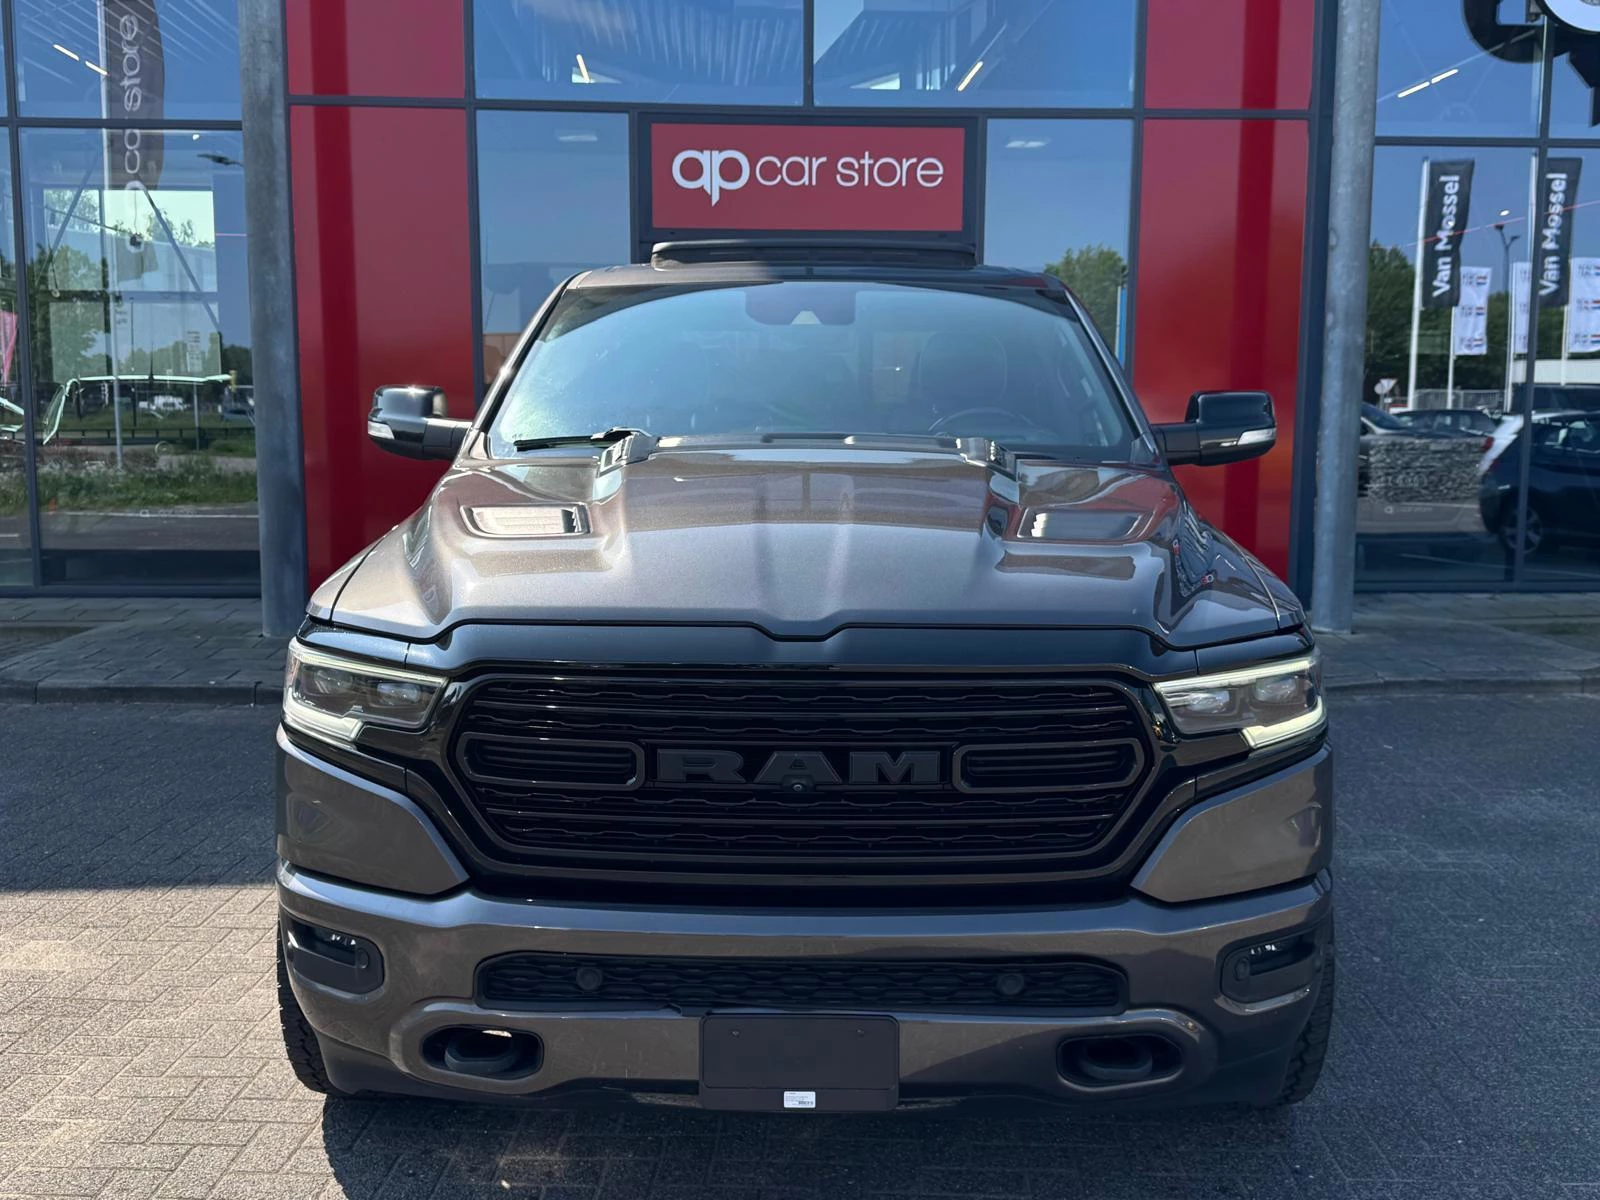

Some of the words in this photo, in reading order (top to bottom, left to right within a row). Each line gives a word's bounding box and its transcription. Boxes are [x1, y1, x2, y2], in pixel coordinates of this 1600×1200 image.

[119, 14, 142, 112] store
[123, 117, 141, 174] ca
[671, 149, 751, 207] ap
[755, 155, 827, 186] car
[836, 150, 944, 187] store
[1433, 174, 1460, 251] Mossel
[1541, 172, 1568, 250] Mossel
[1432, 256, 1452, 298] Van
[1539, 255, 1561, 296] Van
[656, 749, 941, 785] RAM
